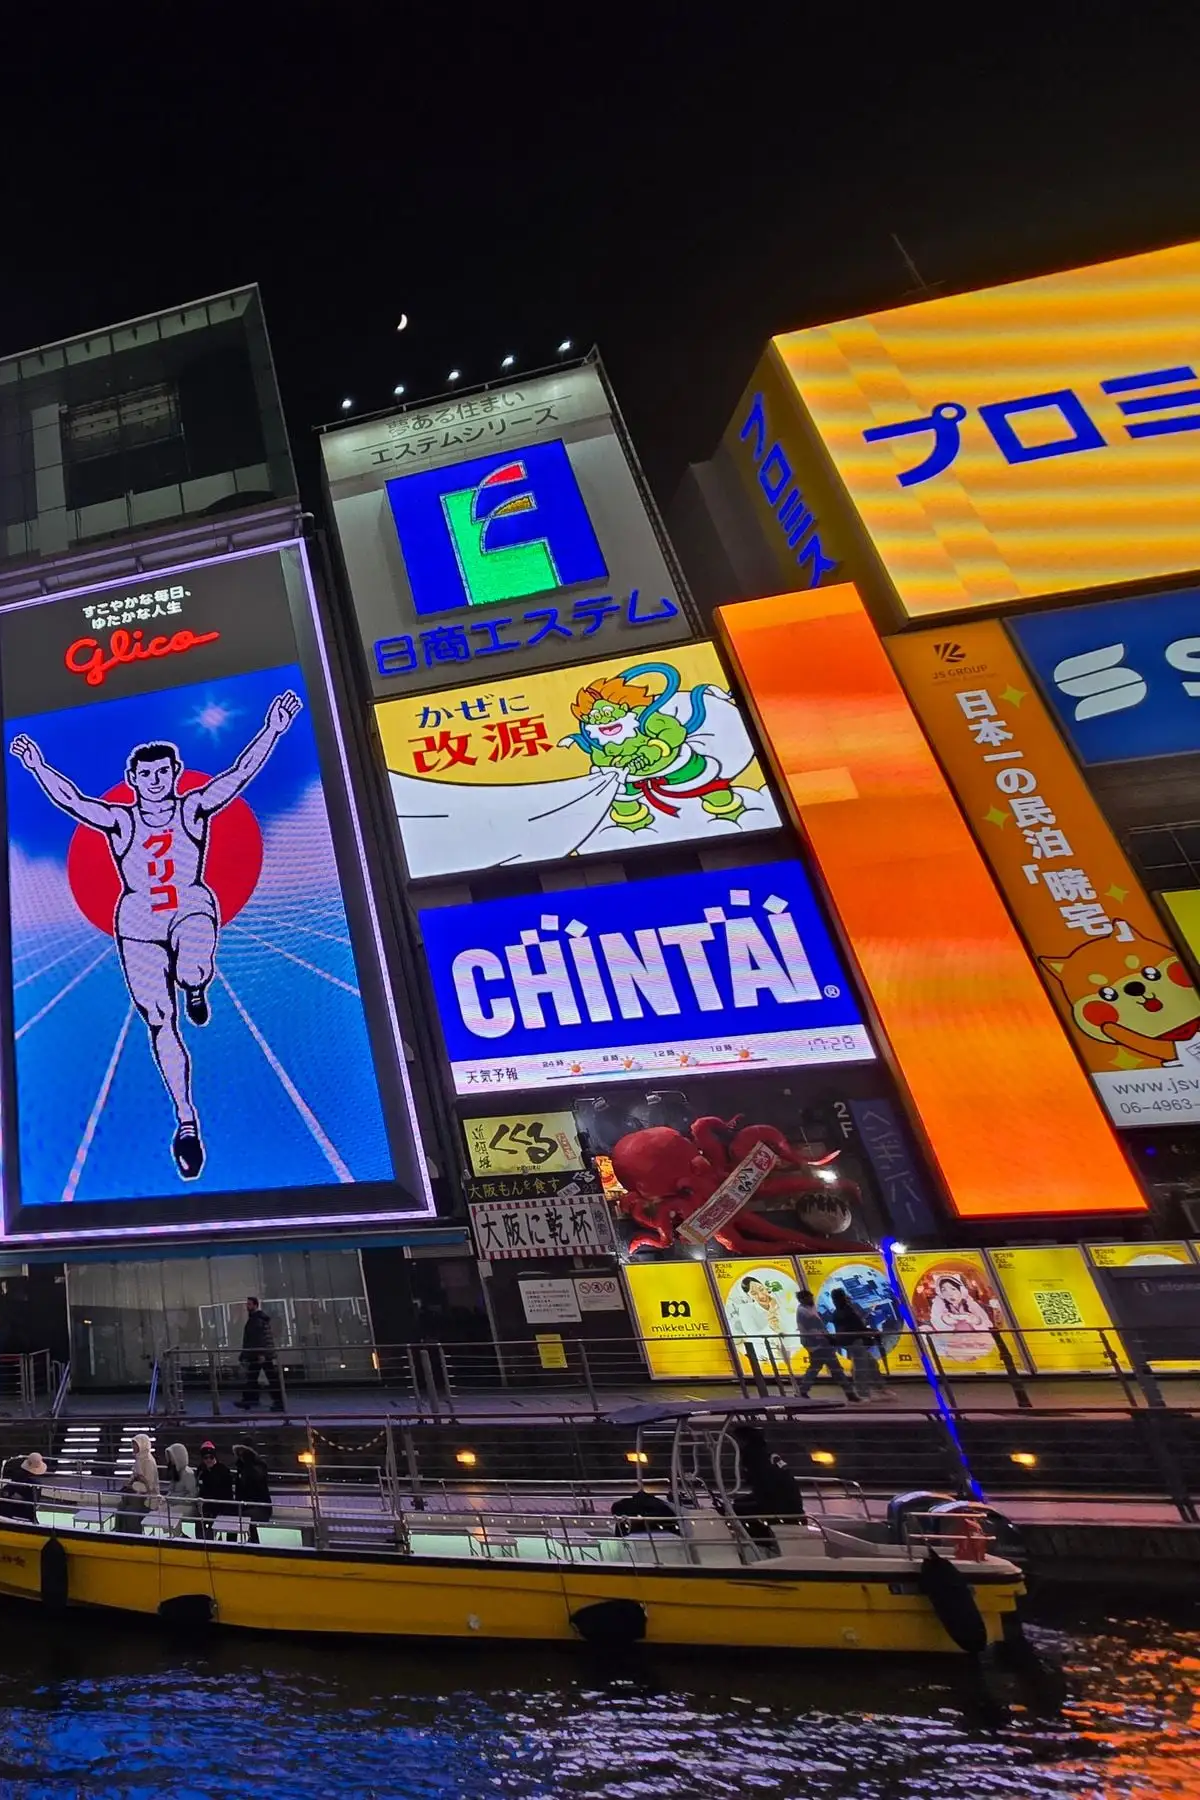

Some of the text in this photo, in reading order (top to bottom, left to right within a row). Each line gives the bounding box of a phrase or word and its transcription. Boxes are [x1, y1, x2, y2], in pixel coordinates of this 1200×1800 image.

[385, 390, 525, 438] 夢ある住まい
[371, 405, 559, 465] エステムシリーズ
[82, 586, 192, 618] すこやかな毎日、
[91, 601, 182, 630] ゆたかな人生
[373, 589, 679, 676] 日商エステム
[947, 664, 987, 677] GROUP
[415, 693, 530, 729] かぜに
[407, 714, 553, 773] 改源
[143, 829, 178, 912] グリコ
[451, 889, 823, 1039] CHINTAI
[465, 1069, 518, 1085] 天気予報
[833, 1101, 854, 1139] 2F
[488, 1122, 558, 1164] くくる
[468, 1177, 560, 1199] 大阪もんを食す
[481, 1207, 592, 1248] 大阪に乾杯
[651, 1323, 710, 1333] mikkeLIVE
